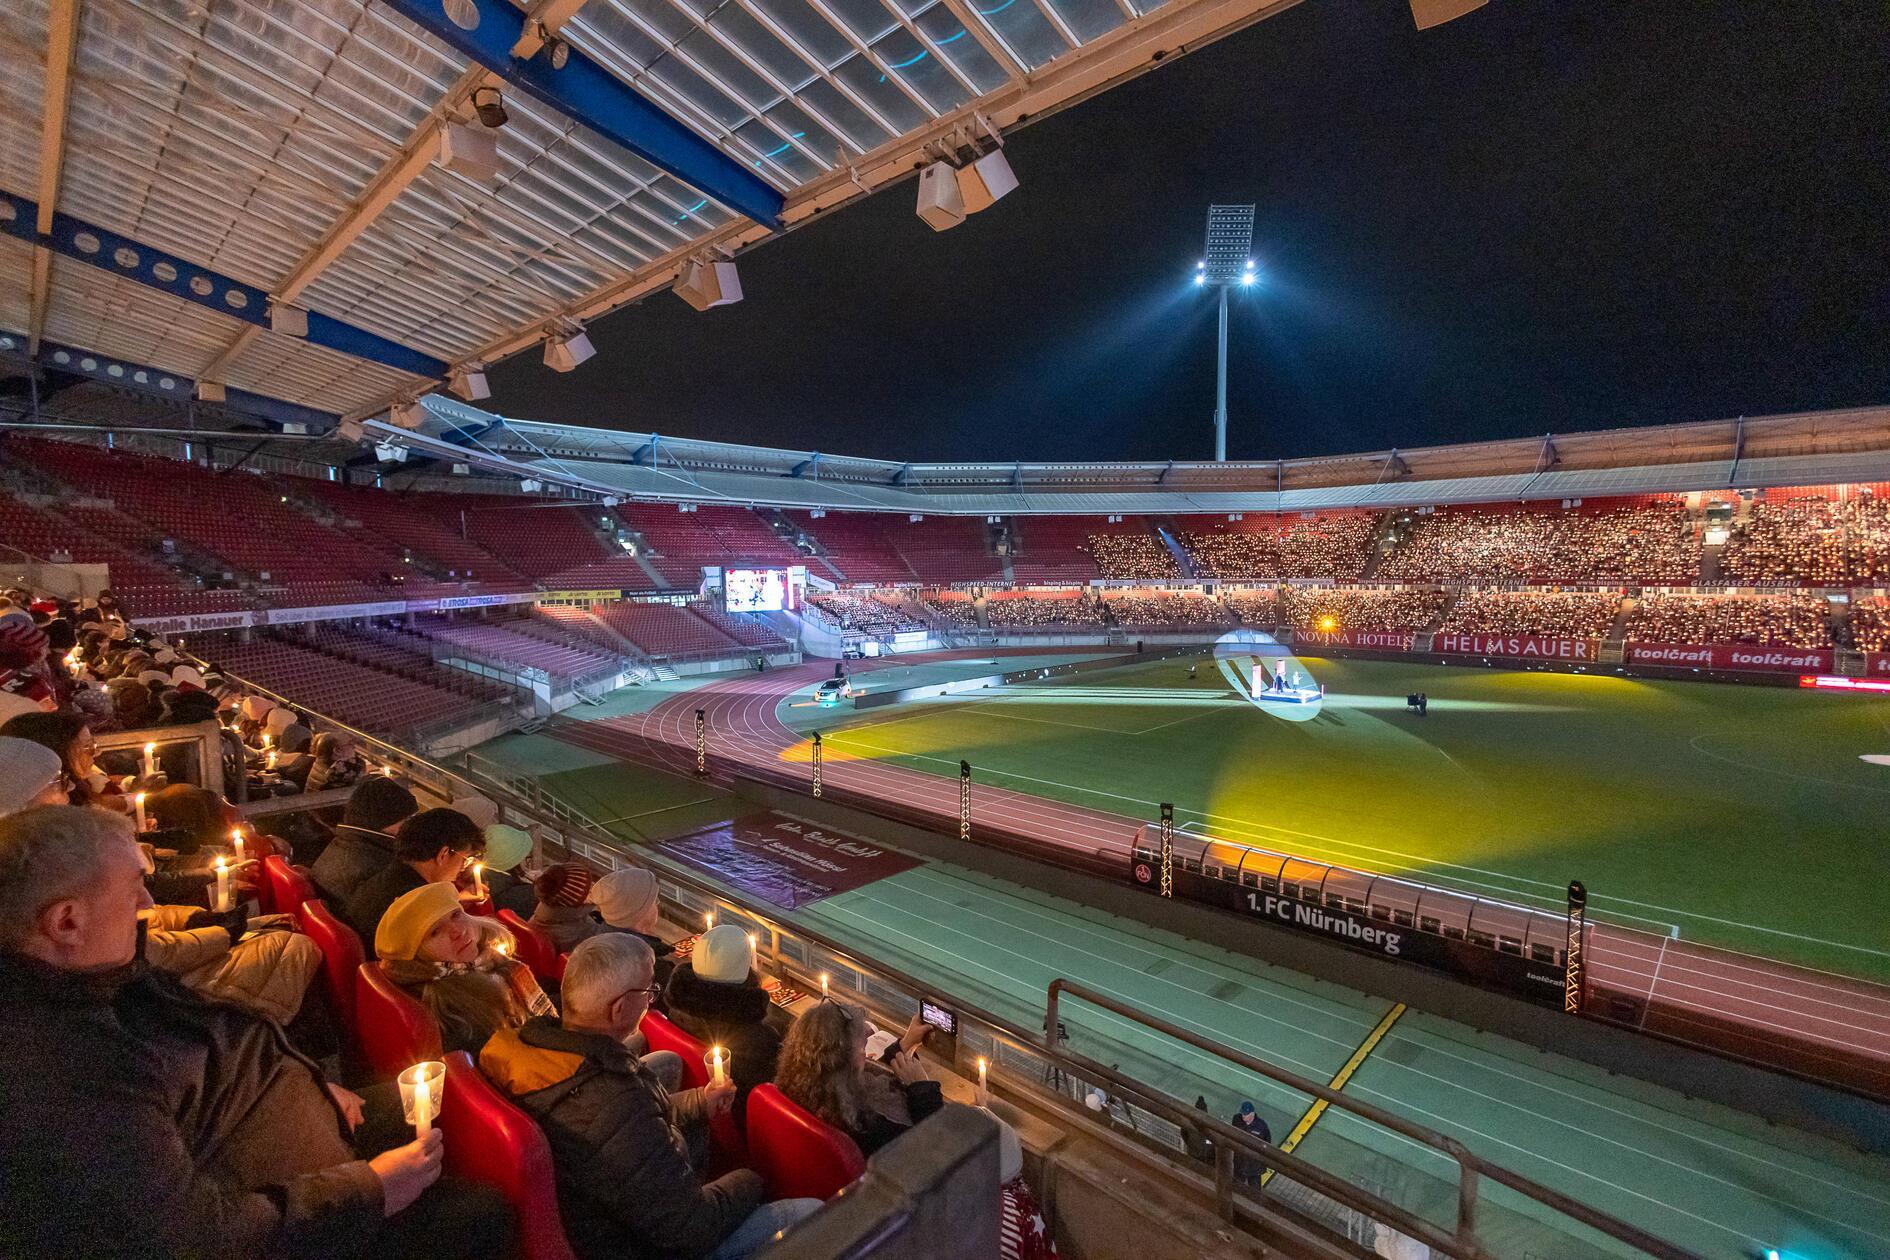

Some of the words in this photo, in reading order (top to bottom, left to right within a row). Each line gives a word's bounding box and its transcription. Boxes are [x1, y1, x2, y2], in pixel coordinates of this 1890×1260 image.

[1690, 579, 1801, 588] GLASFASER-AUSBAU
[190, 615, 244, 631] Hanauer
[1296, 631, 1350, 644] NOVINA
[1357, 633, 1414, 647] HOTELS
[1443, 636, 1587, 658] HELMSAUER
[1247, 892, 1262, 912] 1.
[1265, 897, 1291, 920] FC
[1295, 904, 1401, 955] Nürnberg
